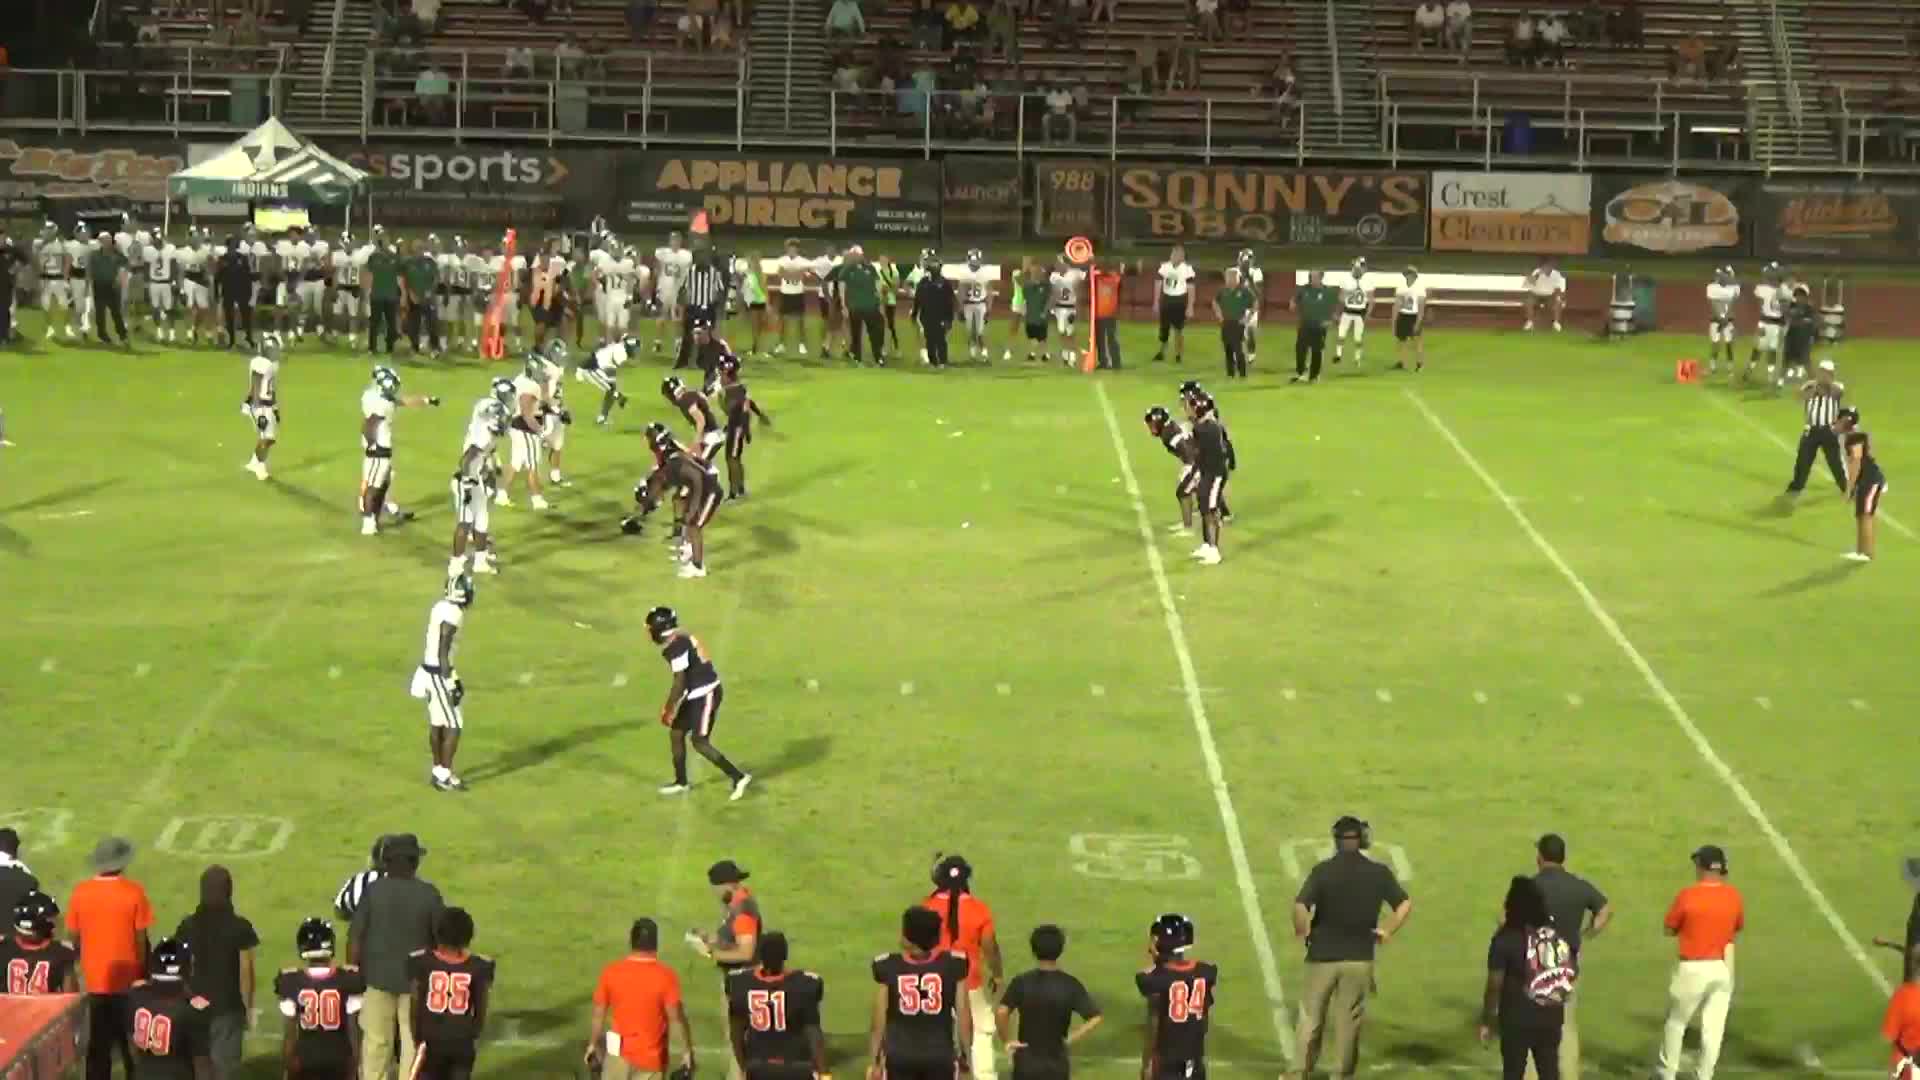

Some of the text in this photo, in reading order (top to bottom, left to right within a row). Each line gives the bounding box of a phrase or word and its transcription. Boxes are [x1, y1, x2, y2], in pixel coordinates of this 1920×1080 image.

[232, 183, 289, 197] INDIANS
[656, 159, 902, 198] APPLIANCE
[1052, 170, 1096, 191] 988
[1122, 168, 1420, 215] SONNY'S
[1441, 182, 1510, 208] Crest
[704, 195, 855, 229] DIRECT
[1151, 209, 1278, 241] BBQ
[1439, 215, 1570, 242] Cleaners
[8, 959, 49, 995] 64
[427, 970, 471, 1014] 85
[898, 972, 942, 1015] 53
[298, 989, 341, 1030] 30
[748, 989, 786, 1031] 51
[1169, 978, 1206, 1023] 84
